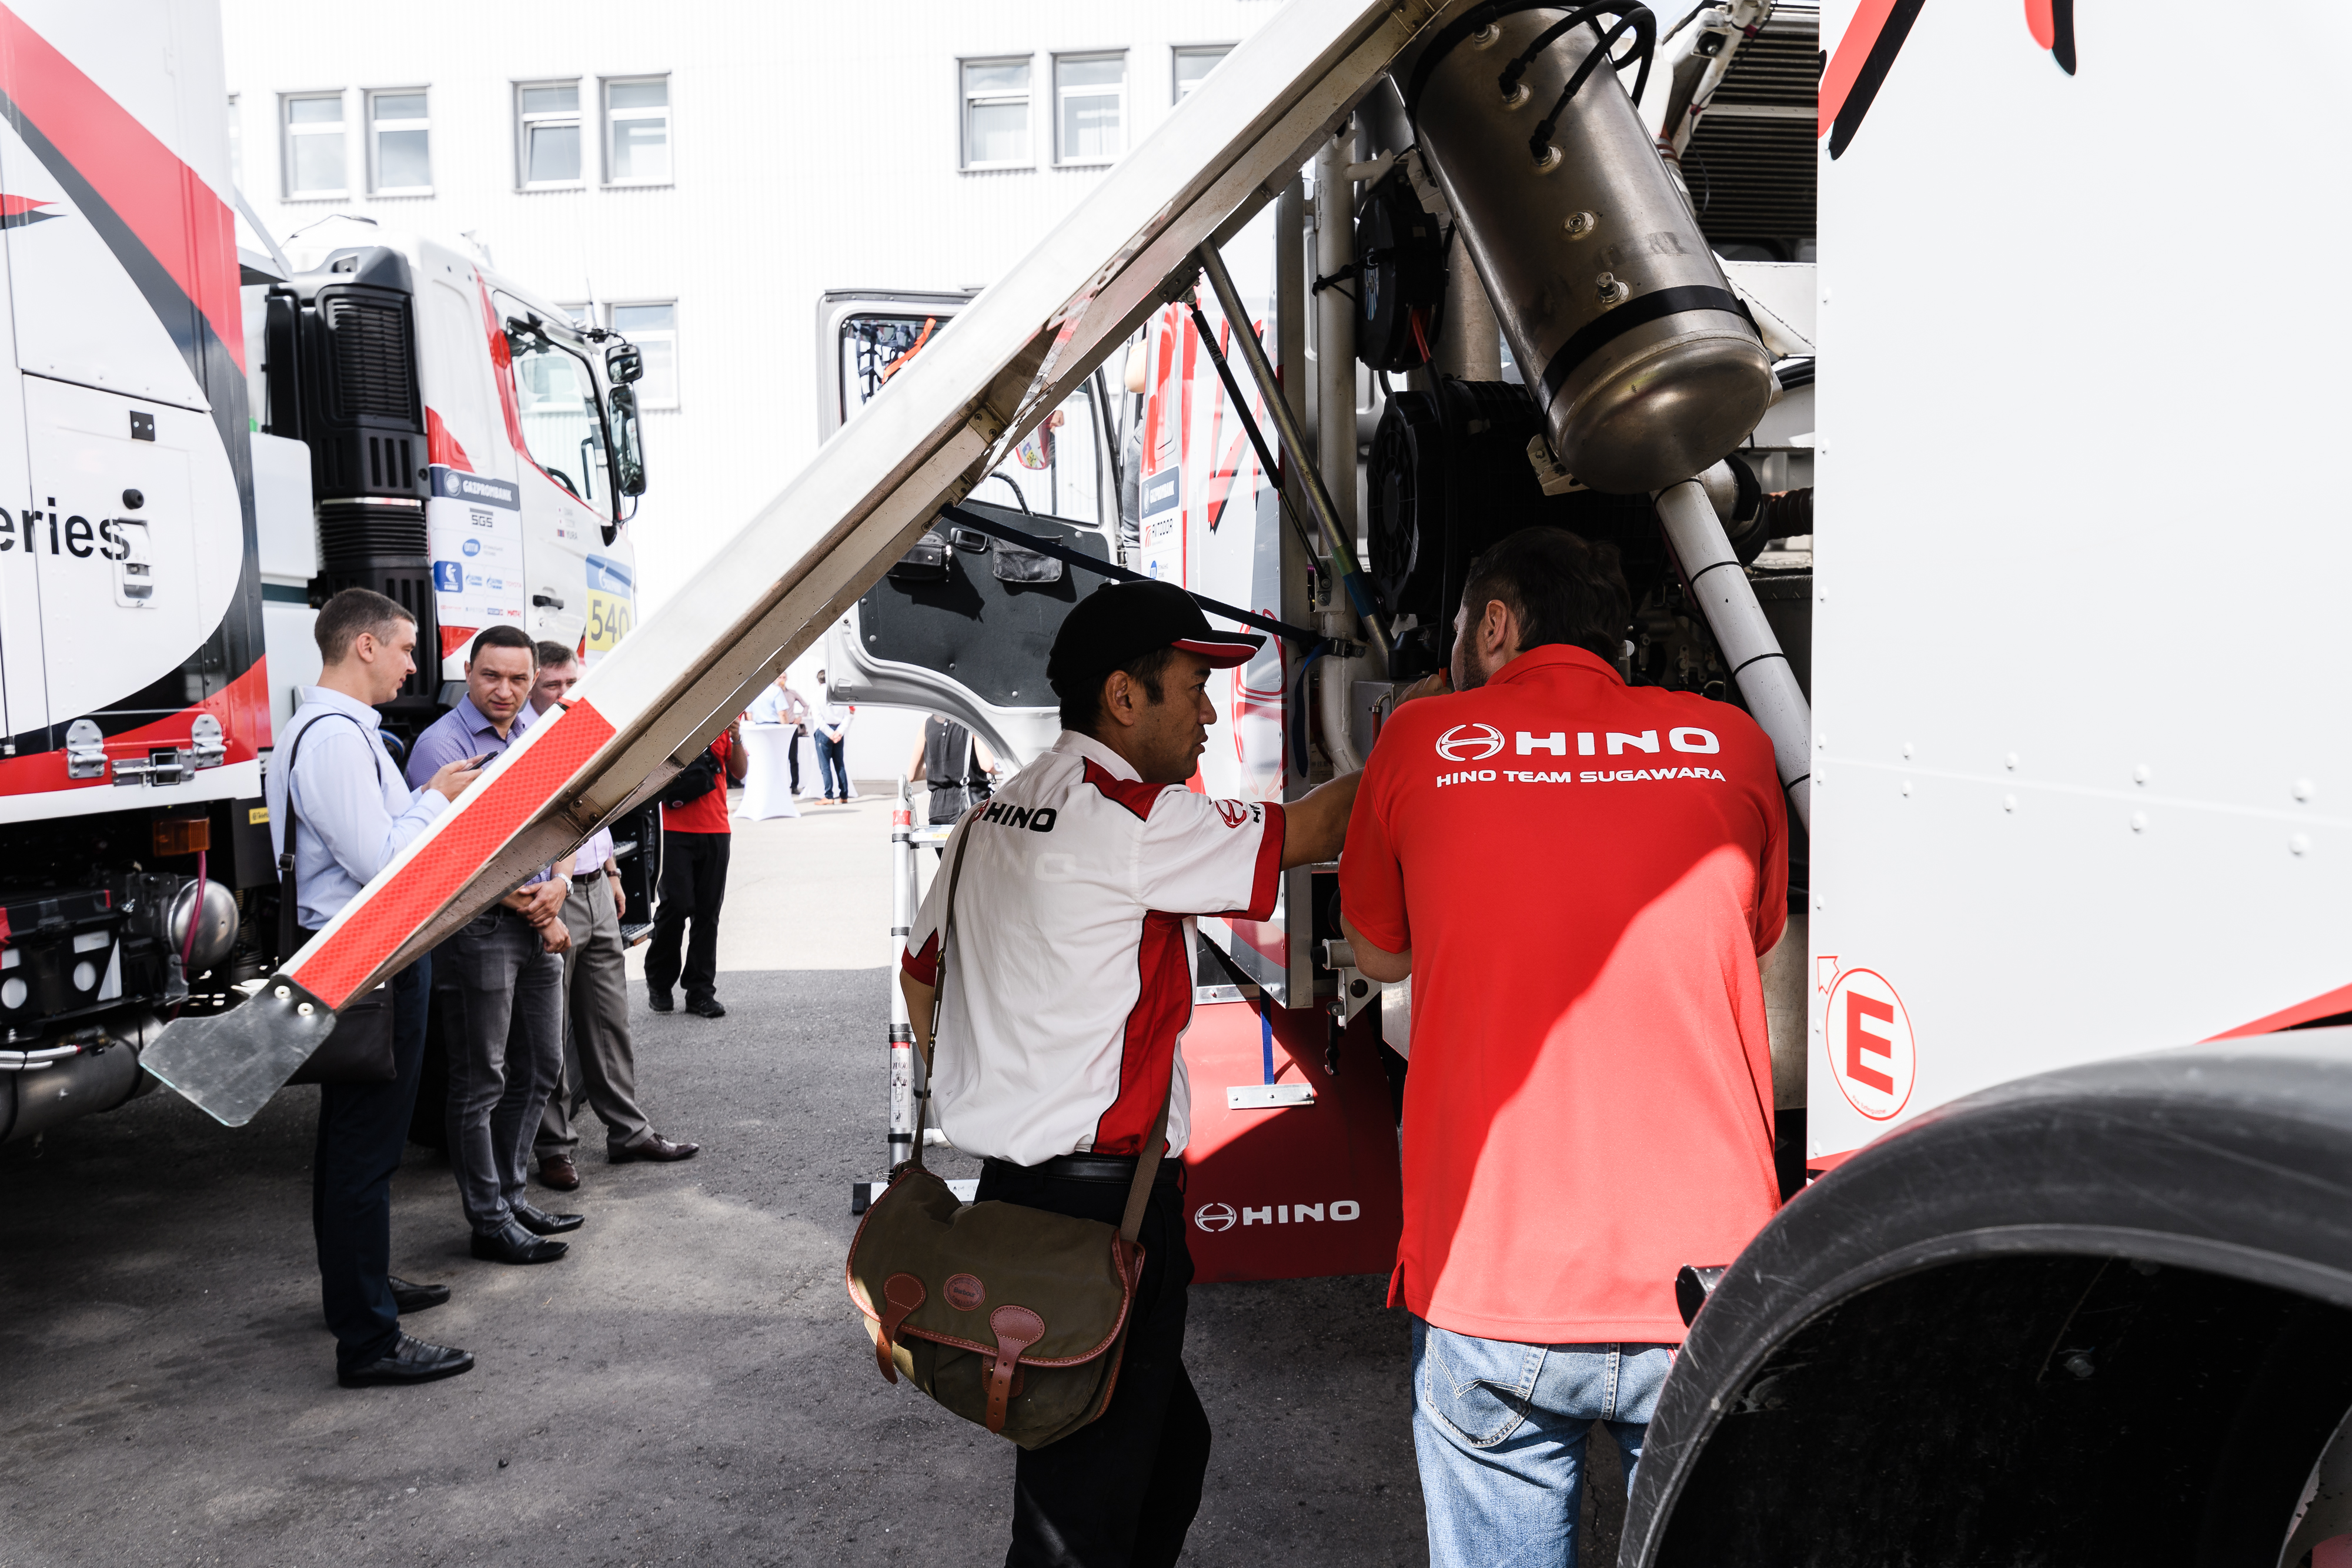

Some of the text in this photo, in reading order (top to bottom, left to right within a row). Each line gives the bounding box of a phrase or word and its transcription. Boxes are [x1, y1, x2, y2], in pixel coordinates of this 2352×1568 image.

[463, 480, 512, 502] GAZPROMBANK
[472, 514, 493, 528] SGS
[1152, 518, 1173, 539] AVTODOR
[590, 599, 629, 643] 540
[1515, 726, 1720, 756] HINO
[1436, 767, 1726, 788] HINO TEAM SUGAWARA
[981, 801, 1057, 833] HINO
[1846, 989, 1894, 1096] E
[1242, 1200, 1361, 1226] HINO
[953, 1286, 976, 1298] Barbour
